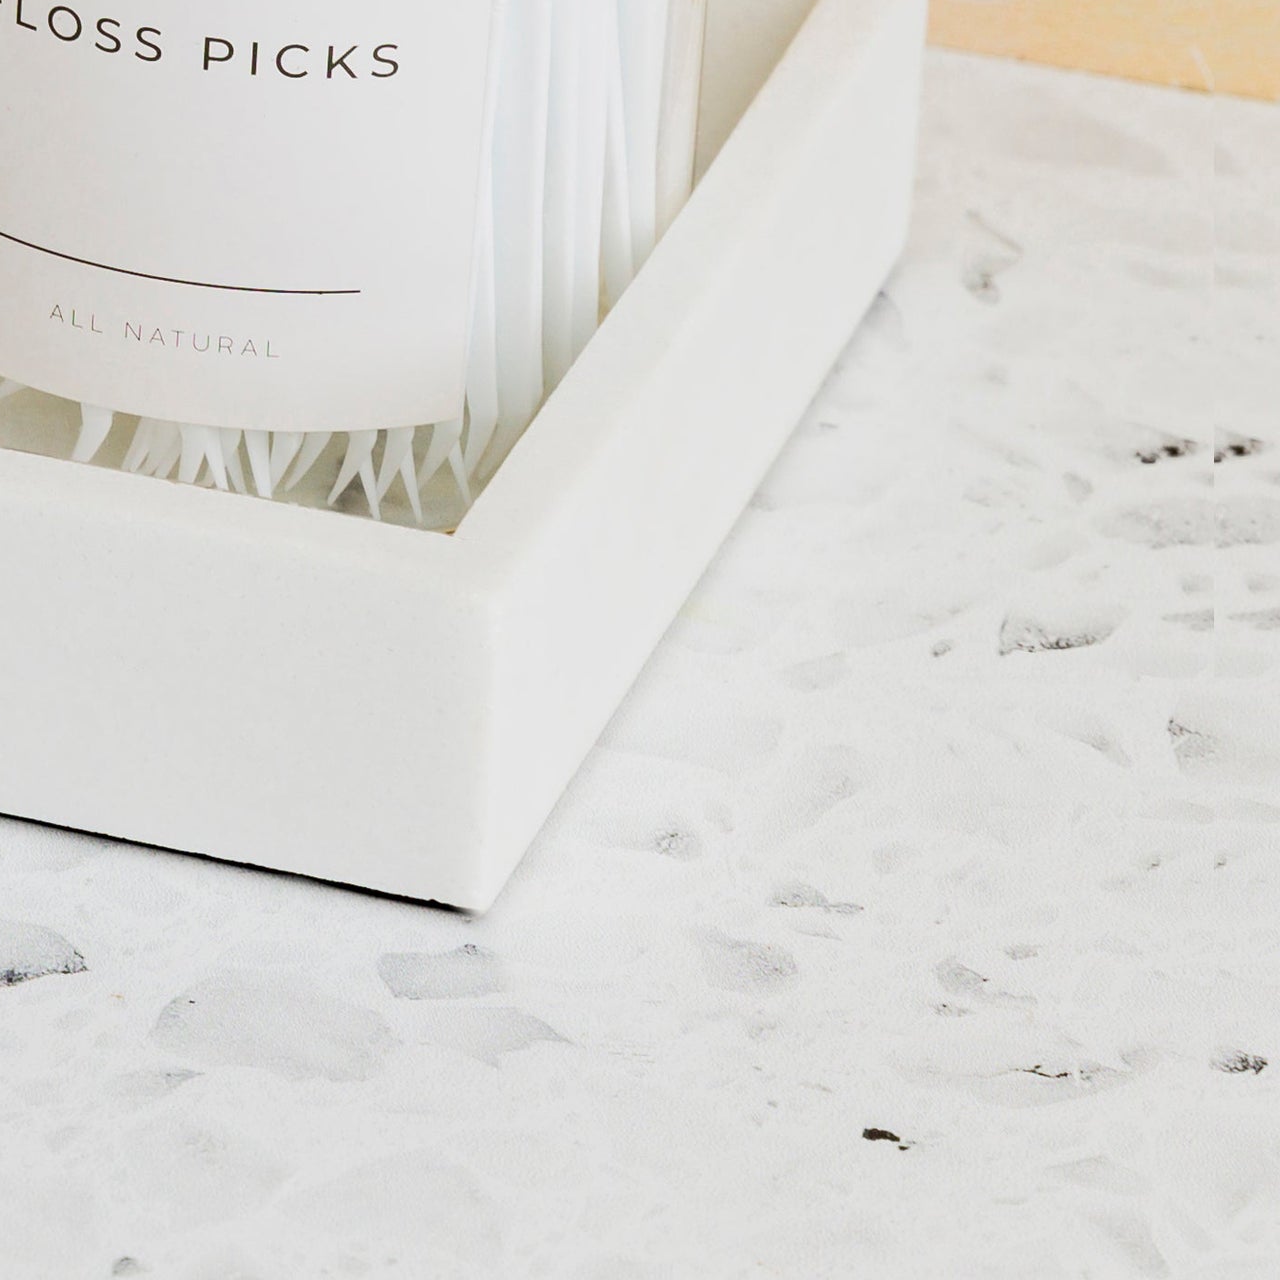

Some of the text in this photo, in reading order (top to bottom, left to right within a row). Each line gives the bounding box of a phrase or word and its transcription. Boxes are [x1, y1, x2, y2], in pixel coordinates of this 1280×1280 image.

[203, 37, 399, 80] PICKS
[50, 304, 280, 359] ALL NATURAL
